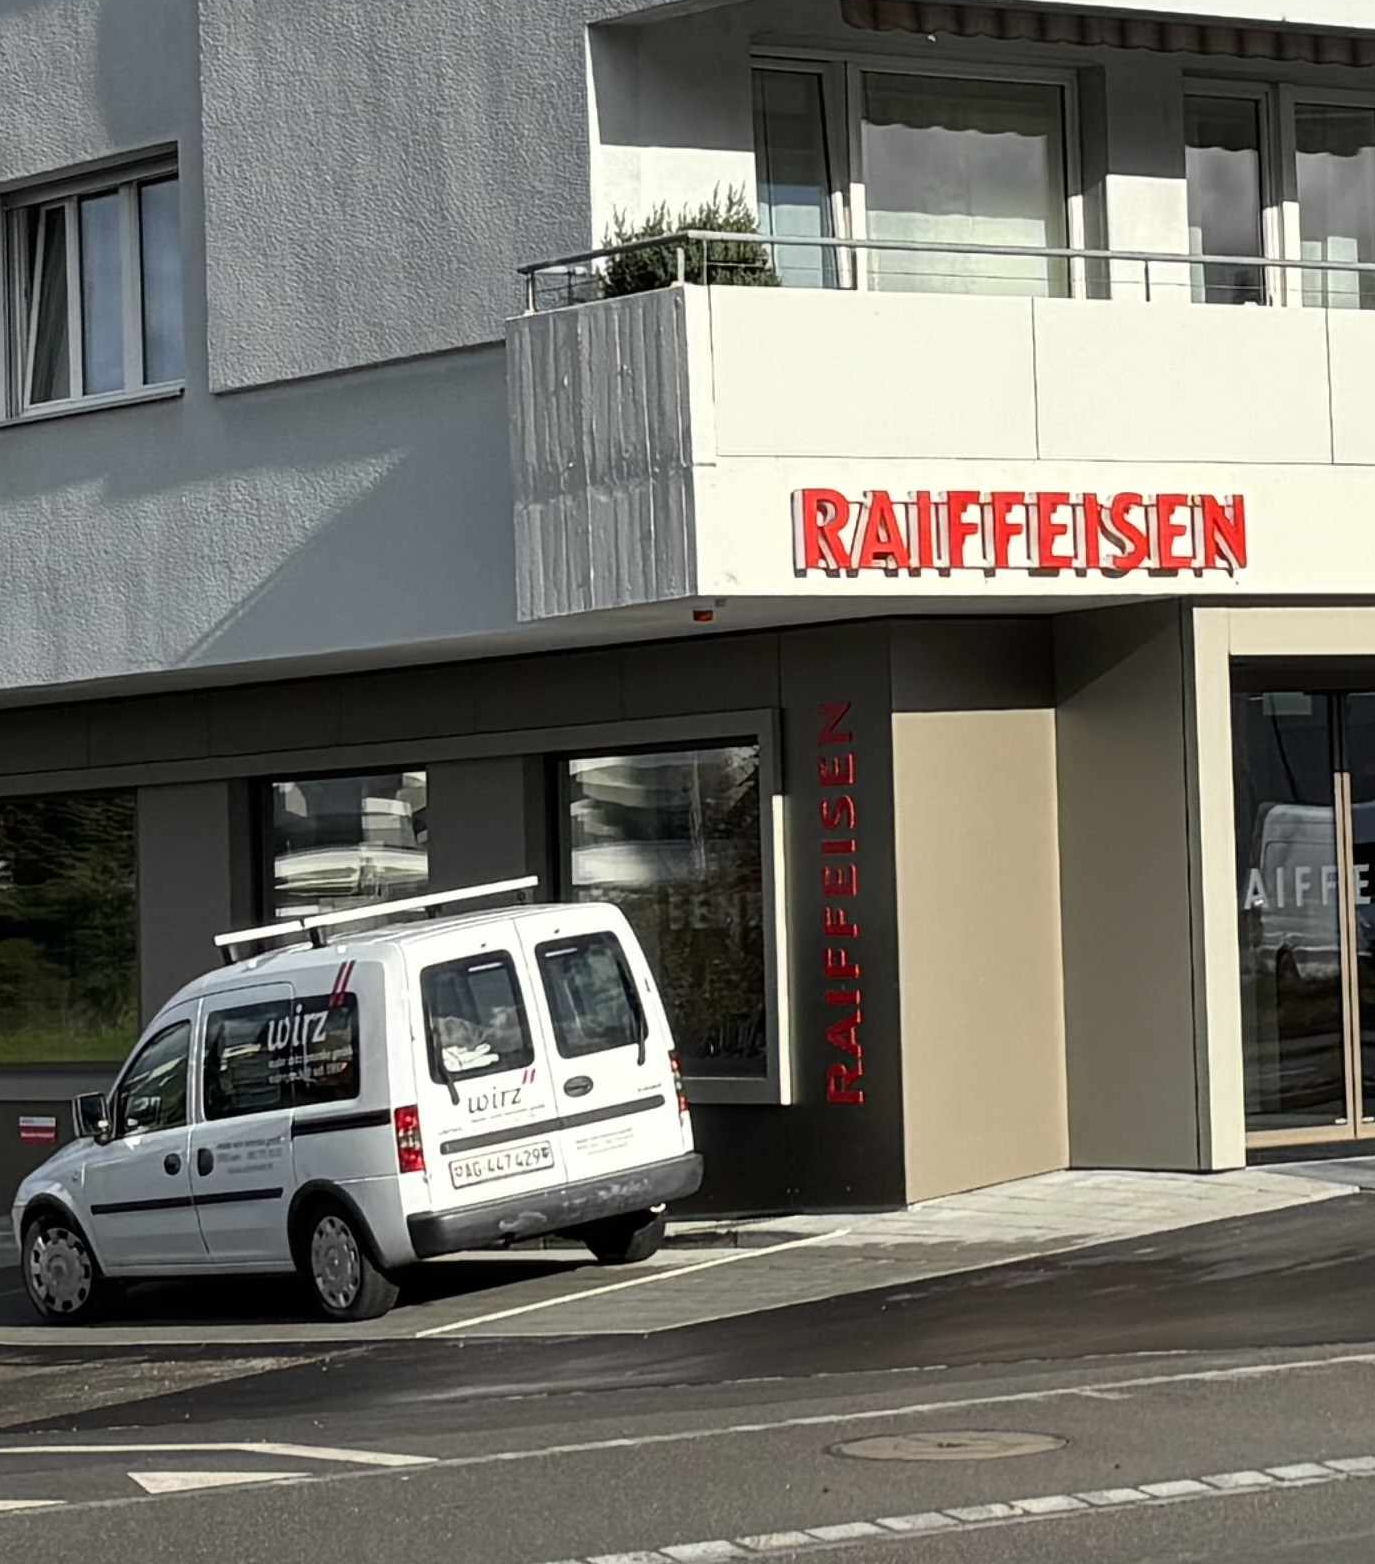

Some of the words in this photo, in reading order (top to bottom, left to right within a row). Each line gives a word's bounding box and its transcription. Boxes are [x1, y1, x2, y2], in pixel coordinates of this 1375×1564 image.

[792, 488, 1247, 576] RAIFFEISEN
[818, 700, 865, 1106] RAIFFEISEN
[268, 1003, 329, 1051] wirz
[468, 1086, 522, 1114] wirz
